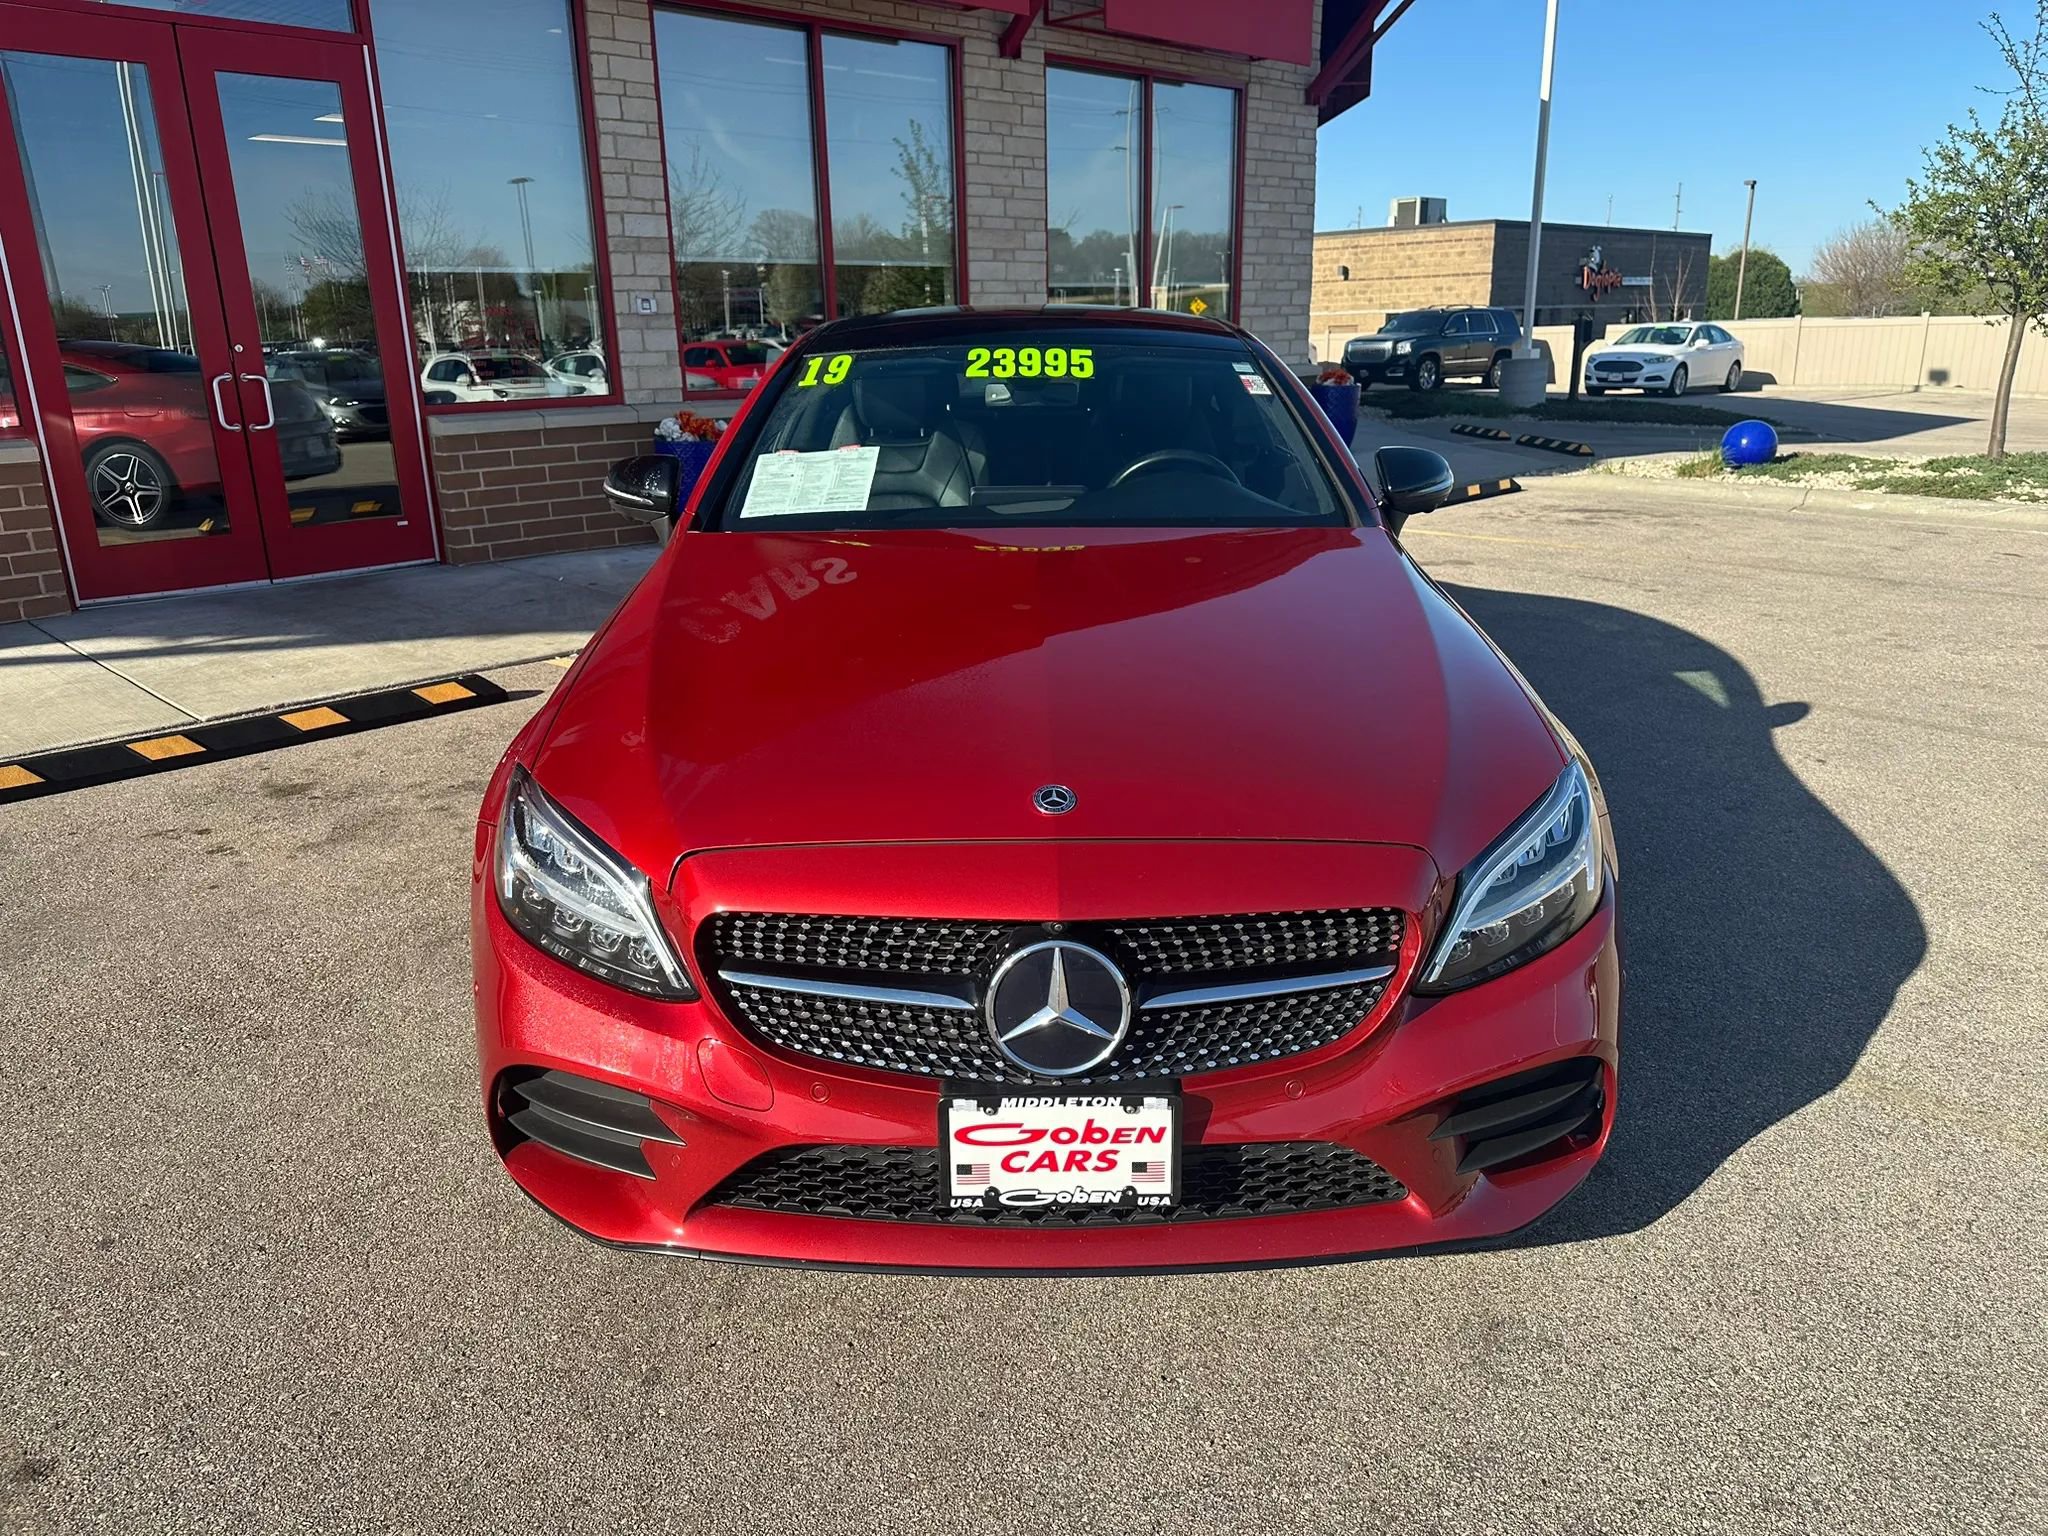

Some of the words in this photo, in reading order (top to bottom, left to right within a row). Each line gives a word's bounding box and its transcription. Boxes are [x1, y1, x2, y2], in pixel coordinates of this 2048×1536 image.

[798, 355, 852, 387] 19
[965, 348, 1094, 378] 23995
[1000, 1097, 1122, 1108] MIDDLETON
[1000, 1150, 1120, 1173] CARS
[951, 1198, 984, 1208] USA
[1137, 1196, 1171, 1206] USA
